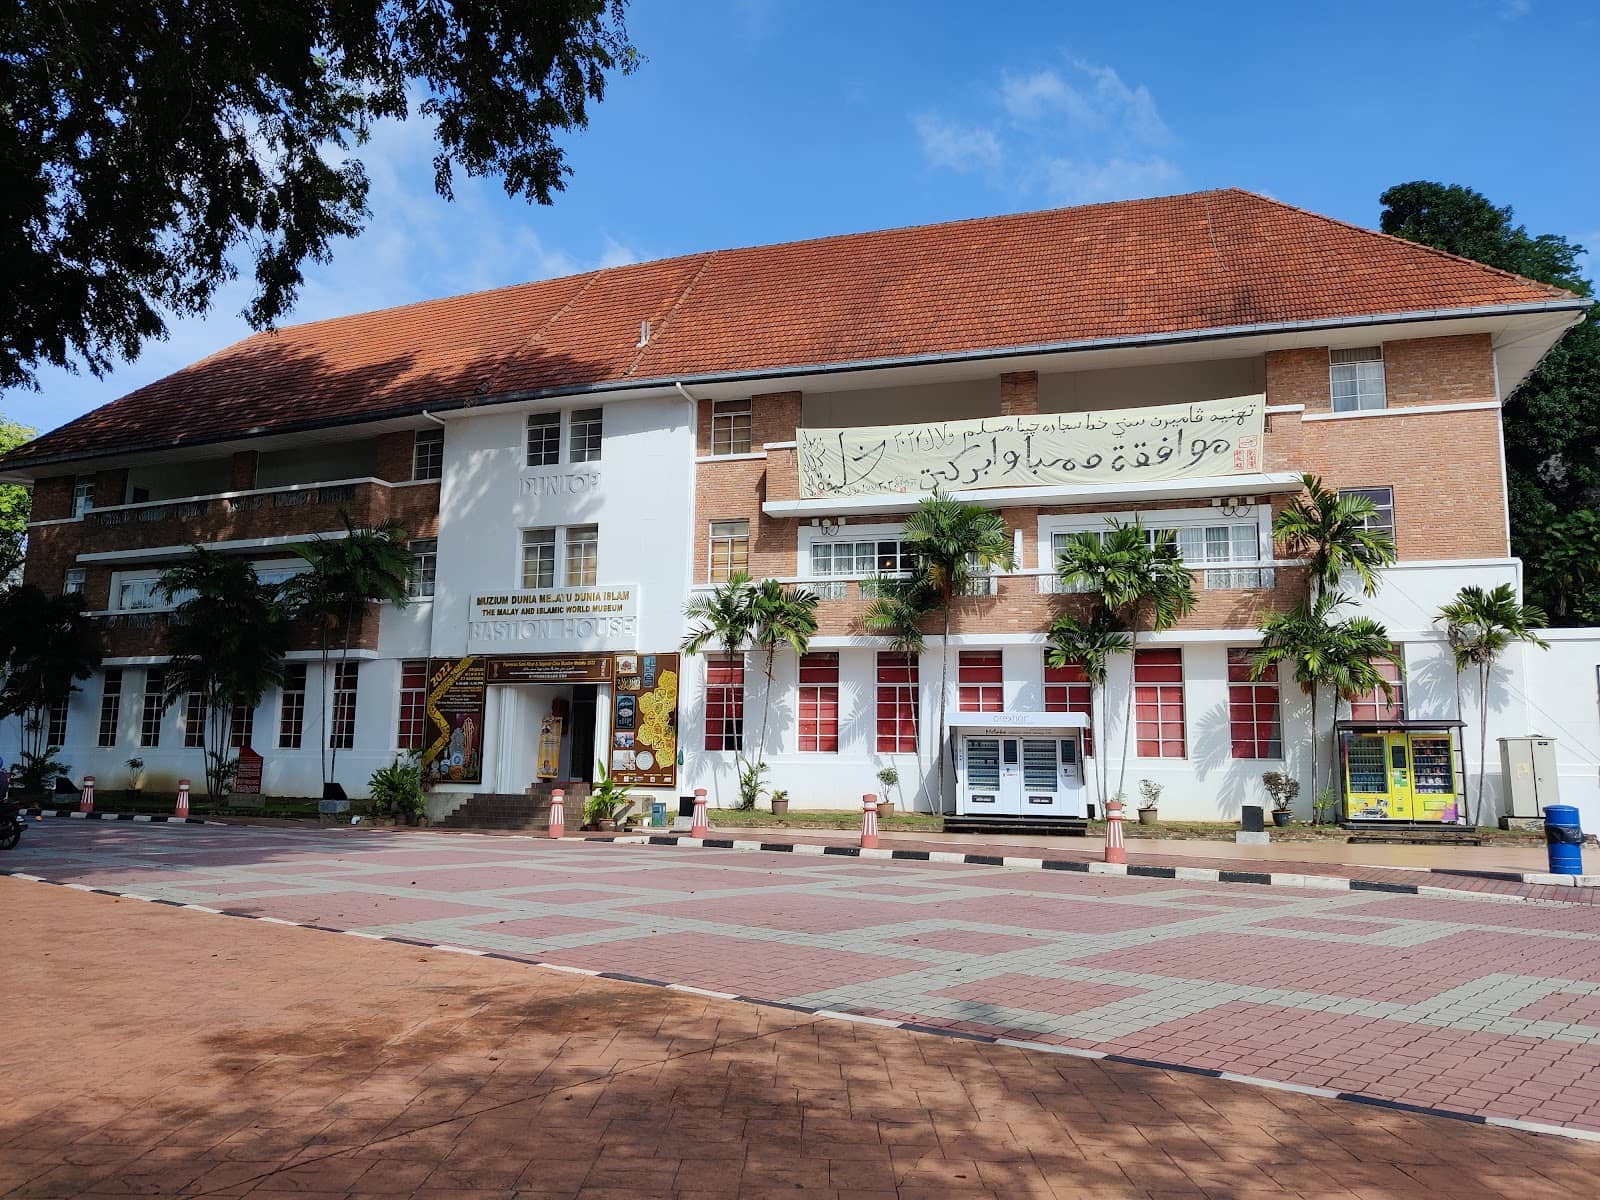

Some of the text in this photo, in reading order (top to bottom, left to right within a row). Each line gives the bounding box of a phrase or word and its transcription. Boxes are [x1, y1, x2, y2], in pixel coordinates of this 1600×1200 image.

[476, 591, 630, 606] MUZIUM DUNIA MELAYU DUNIA ISLAM
[497, 607, 518, 616] MALAY
[521, 607, 535, 615] AND
[536, 606, 564, 615] ISLAMIC
[566, 605, 590, 613] WORLD
[592, 604, 623, 613] MUSEUM
[470, 616, 638, 641] BASTION HOUSE
[430, 661, 453, 688] 2022
